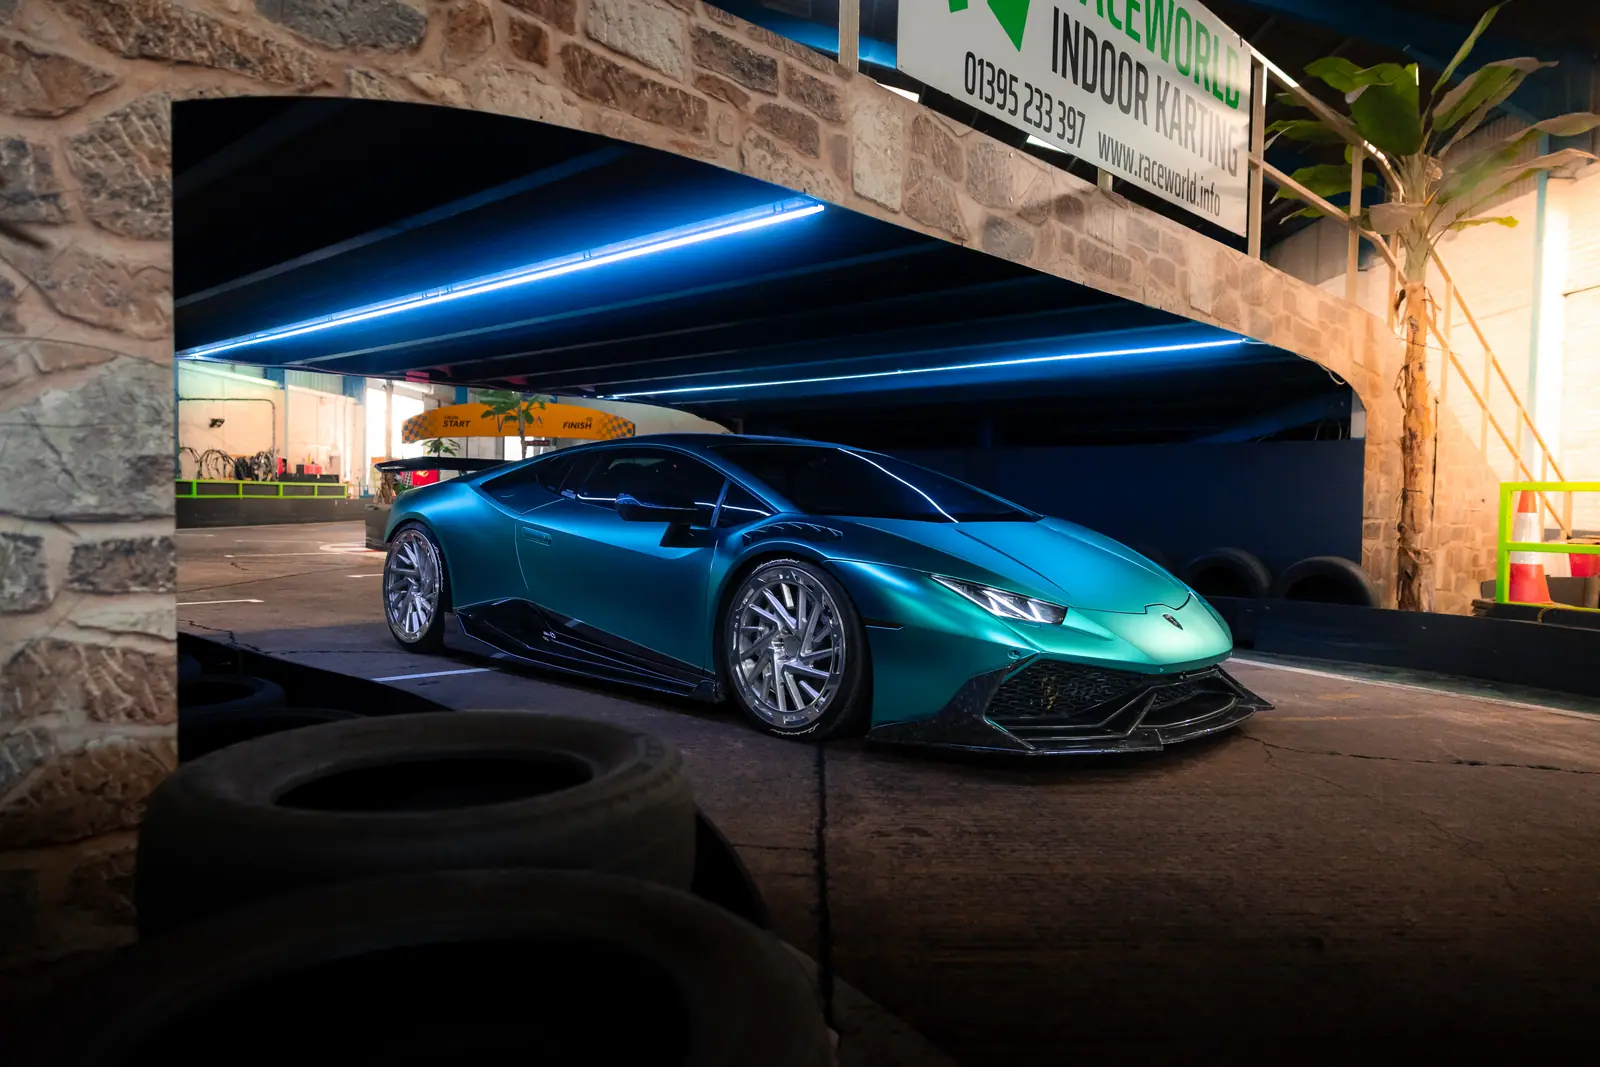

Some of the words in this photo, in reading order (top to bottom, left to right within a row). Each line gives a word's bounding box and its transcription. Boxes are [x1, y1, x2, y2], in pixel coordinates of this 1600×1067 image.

[964, 51, 1019, 117] 01395
[1023, 82, 1054, 134] 233
[1056, 100, 1086, 148] 397
[1051, 6, 1148, 126] INDOOR
[1155, 74, 1238, 177] KARTING
[1079, 0, 1239, 109] EWORLD
[1098, 131, 1221, 217] www.raceworld.info
[442, 420, 471, 428] START
[562, 421, 593, 430] FINISH
